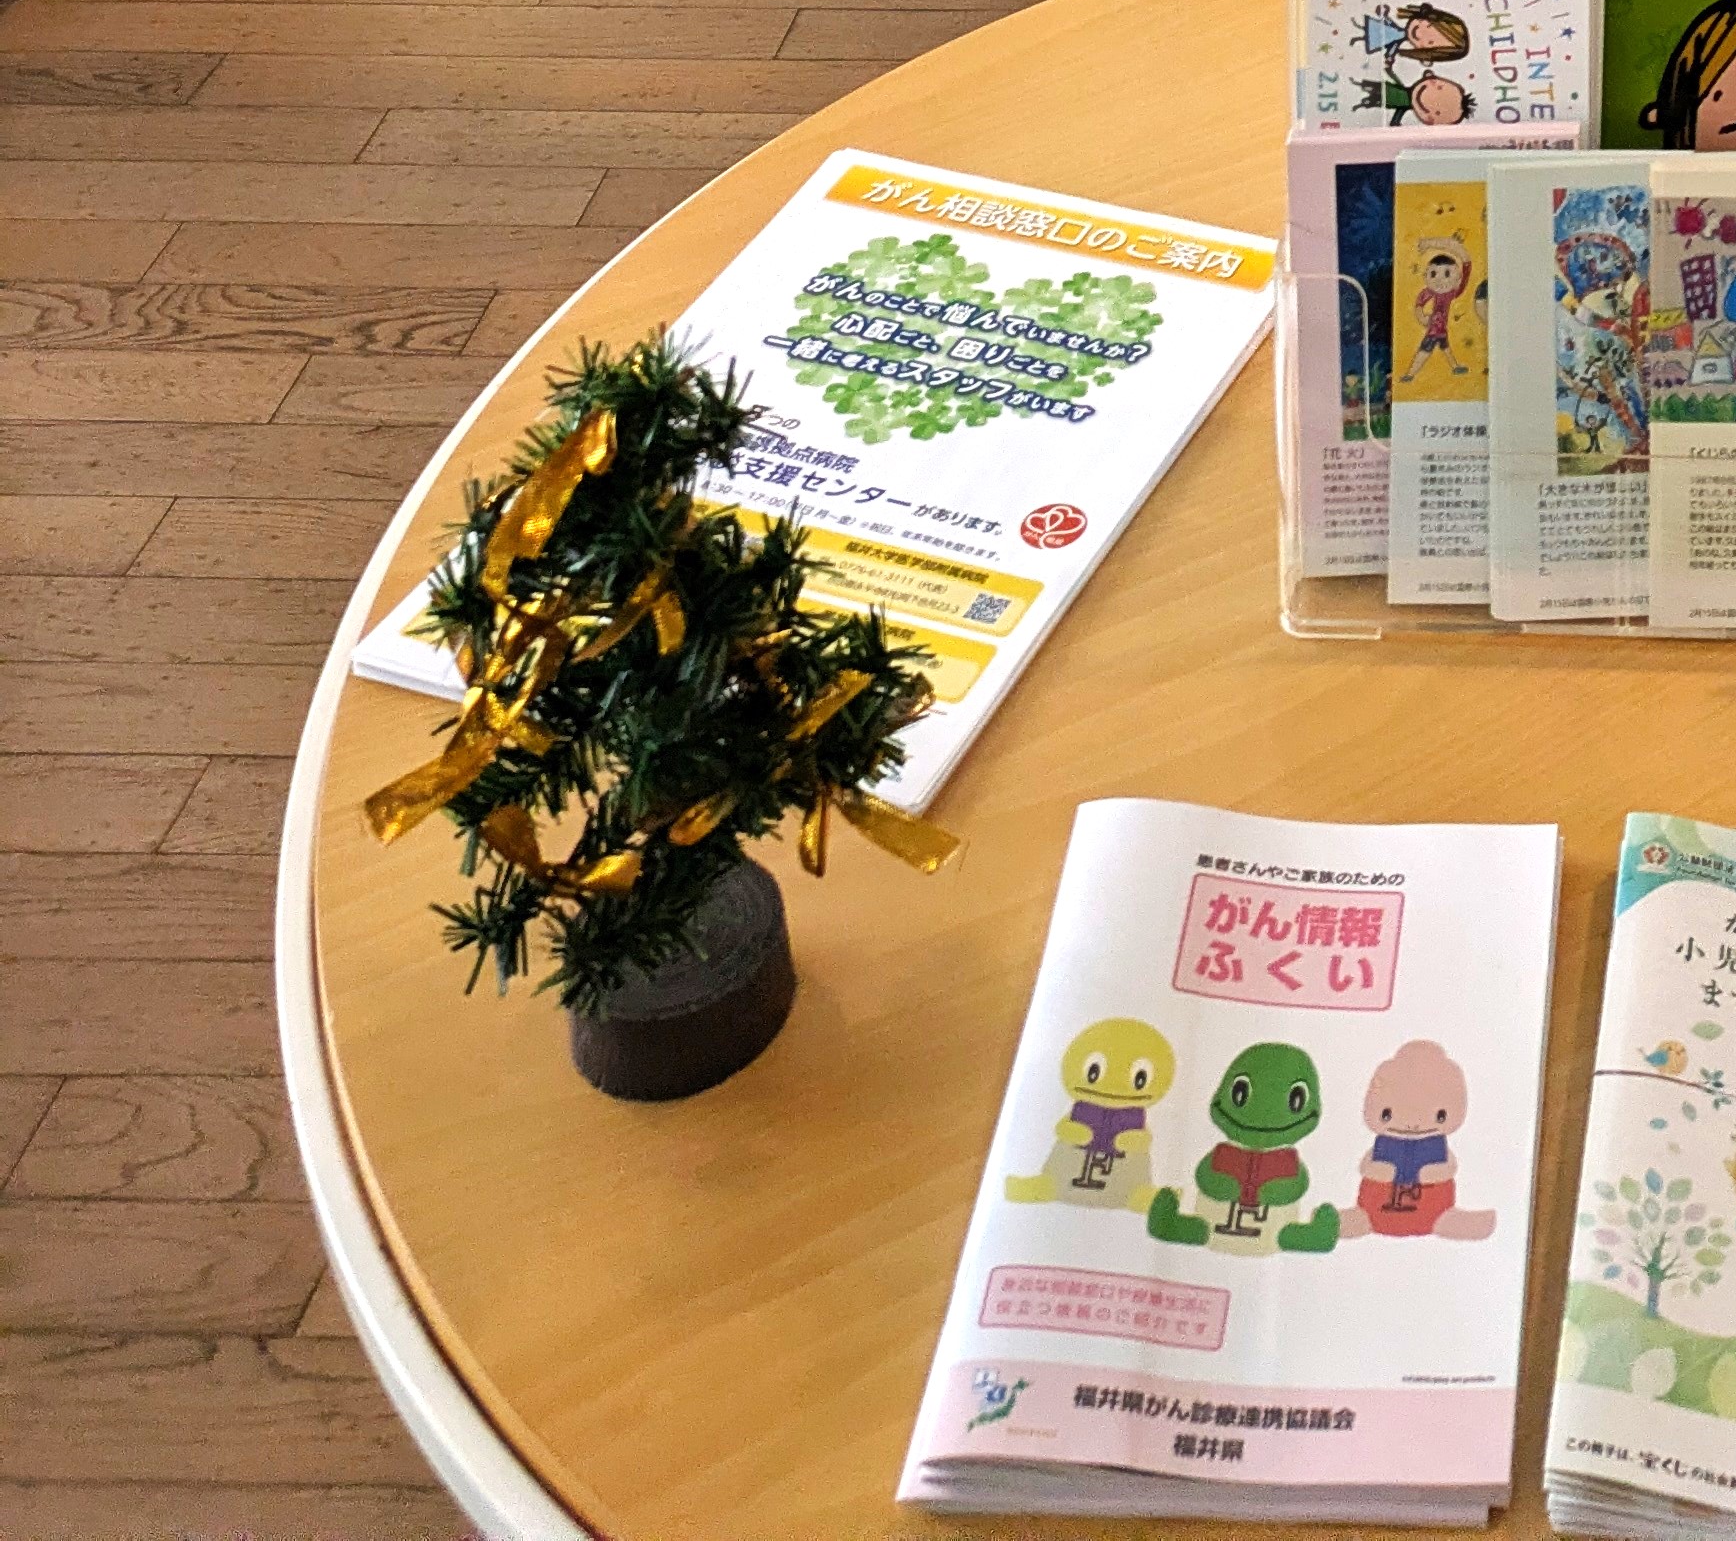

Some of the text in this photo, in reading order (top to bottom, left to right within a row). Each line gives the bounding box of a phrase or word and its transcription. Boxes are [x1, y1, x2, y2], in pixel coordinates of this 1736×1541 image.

[1318, 71, 1339, 112] 2.15
[862, 178, 1245, 279] がん相談窓口のご案内
[804, 274, 1150, 363] がんのことで悩んでいませんか?
[834, 313, 1069, 380] 心配ごと、困りごとを
[764, 333, 1095, 423] 一緒に考えるスタッフがいます
[1196, 854, 1405, 886] 患者さんやご家族のための
[1205, 894, 1384, 947] がん情報
[1196, 941, 1373, 992] ふくい
[1073, 1384, 1356, 1431] 福井県がん診療連携協議会
[1173, 1435, 1244, 1461] 福井県
